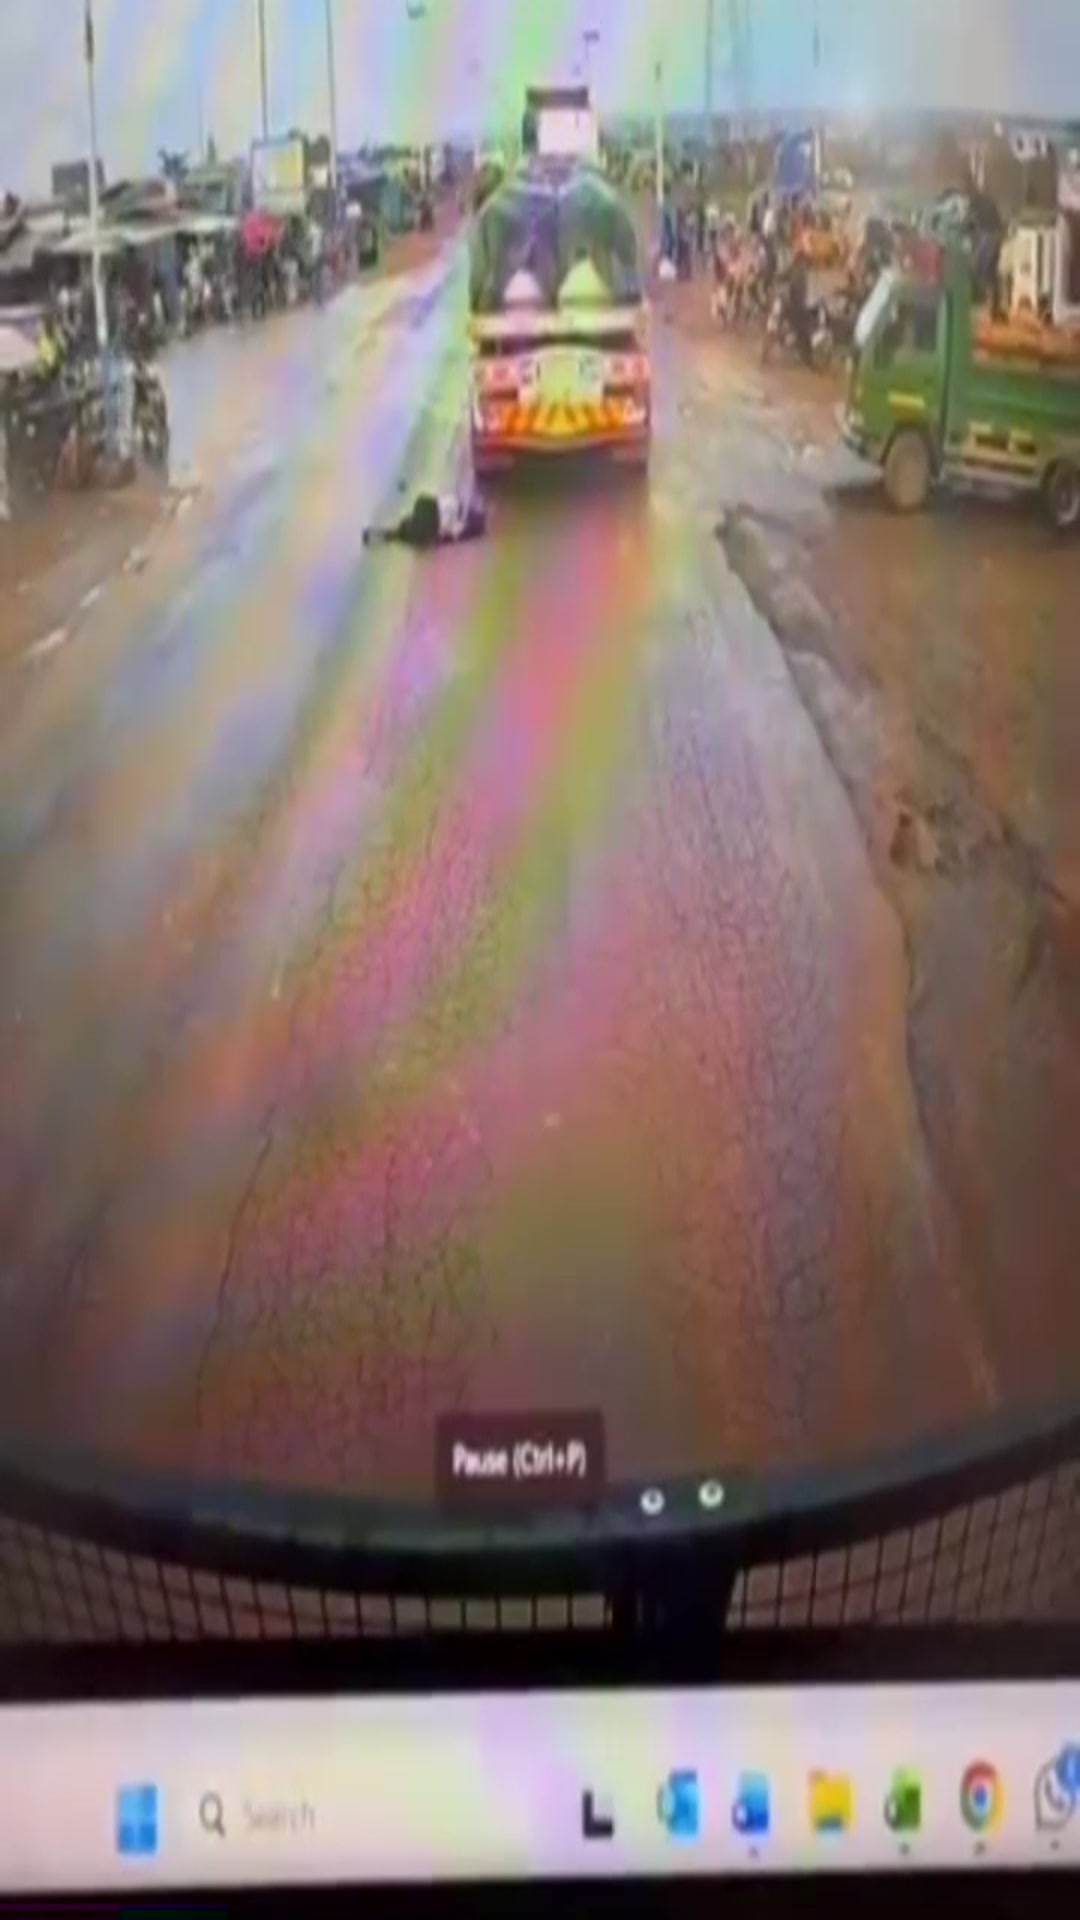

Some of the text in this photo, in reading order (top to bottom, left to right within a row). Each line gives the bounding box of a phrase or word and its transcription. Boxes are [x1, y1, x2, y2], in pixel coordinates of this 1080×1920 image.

[452, 1440, 588, 1479] Pause (Ctrl+P)
[243, 1796, 317, 1832] Search
